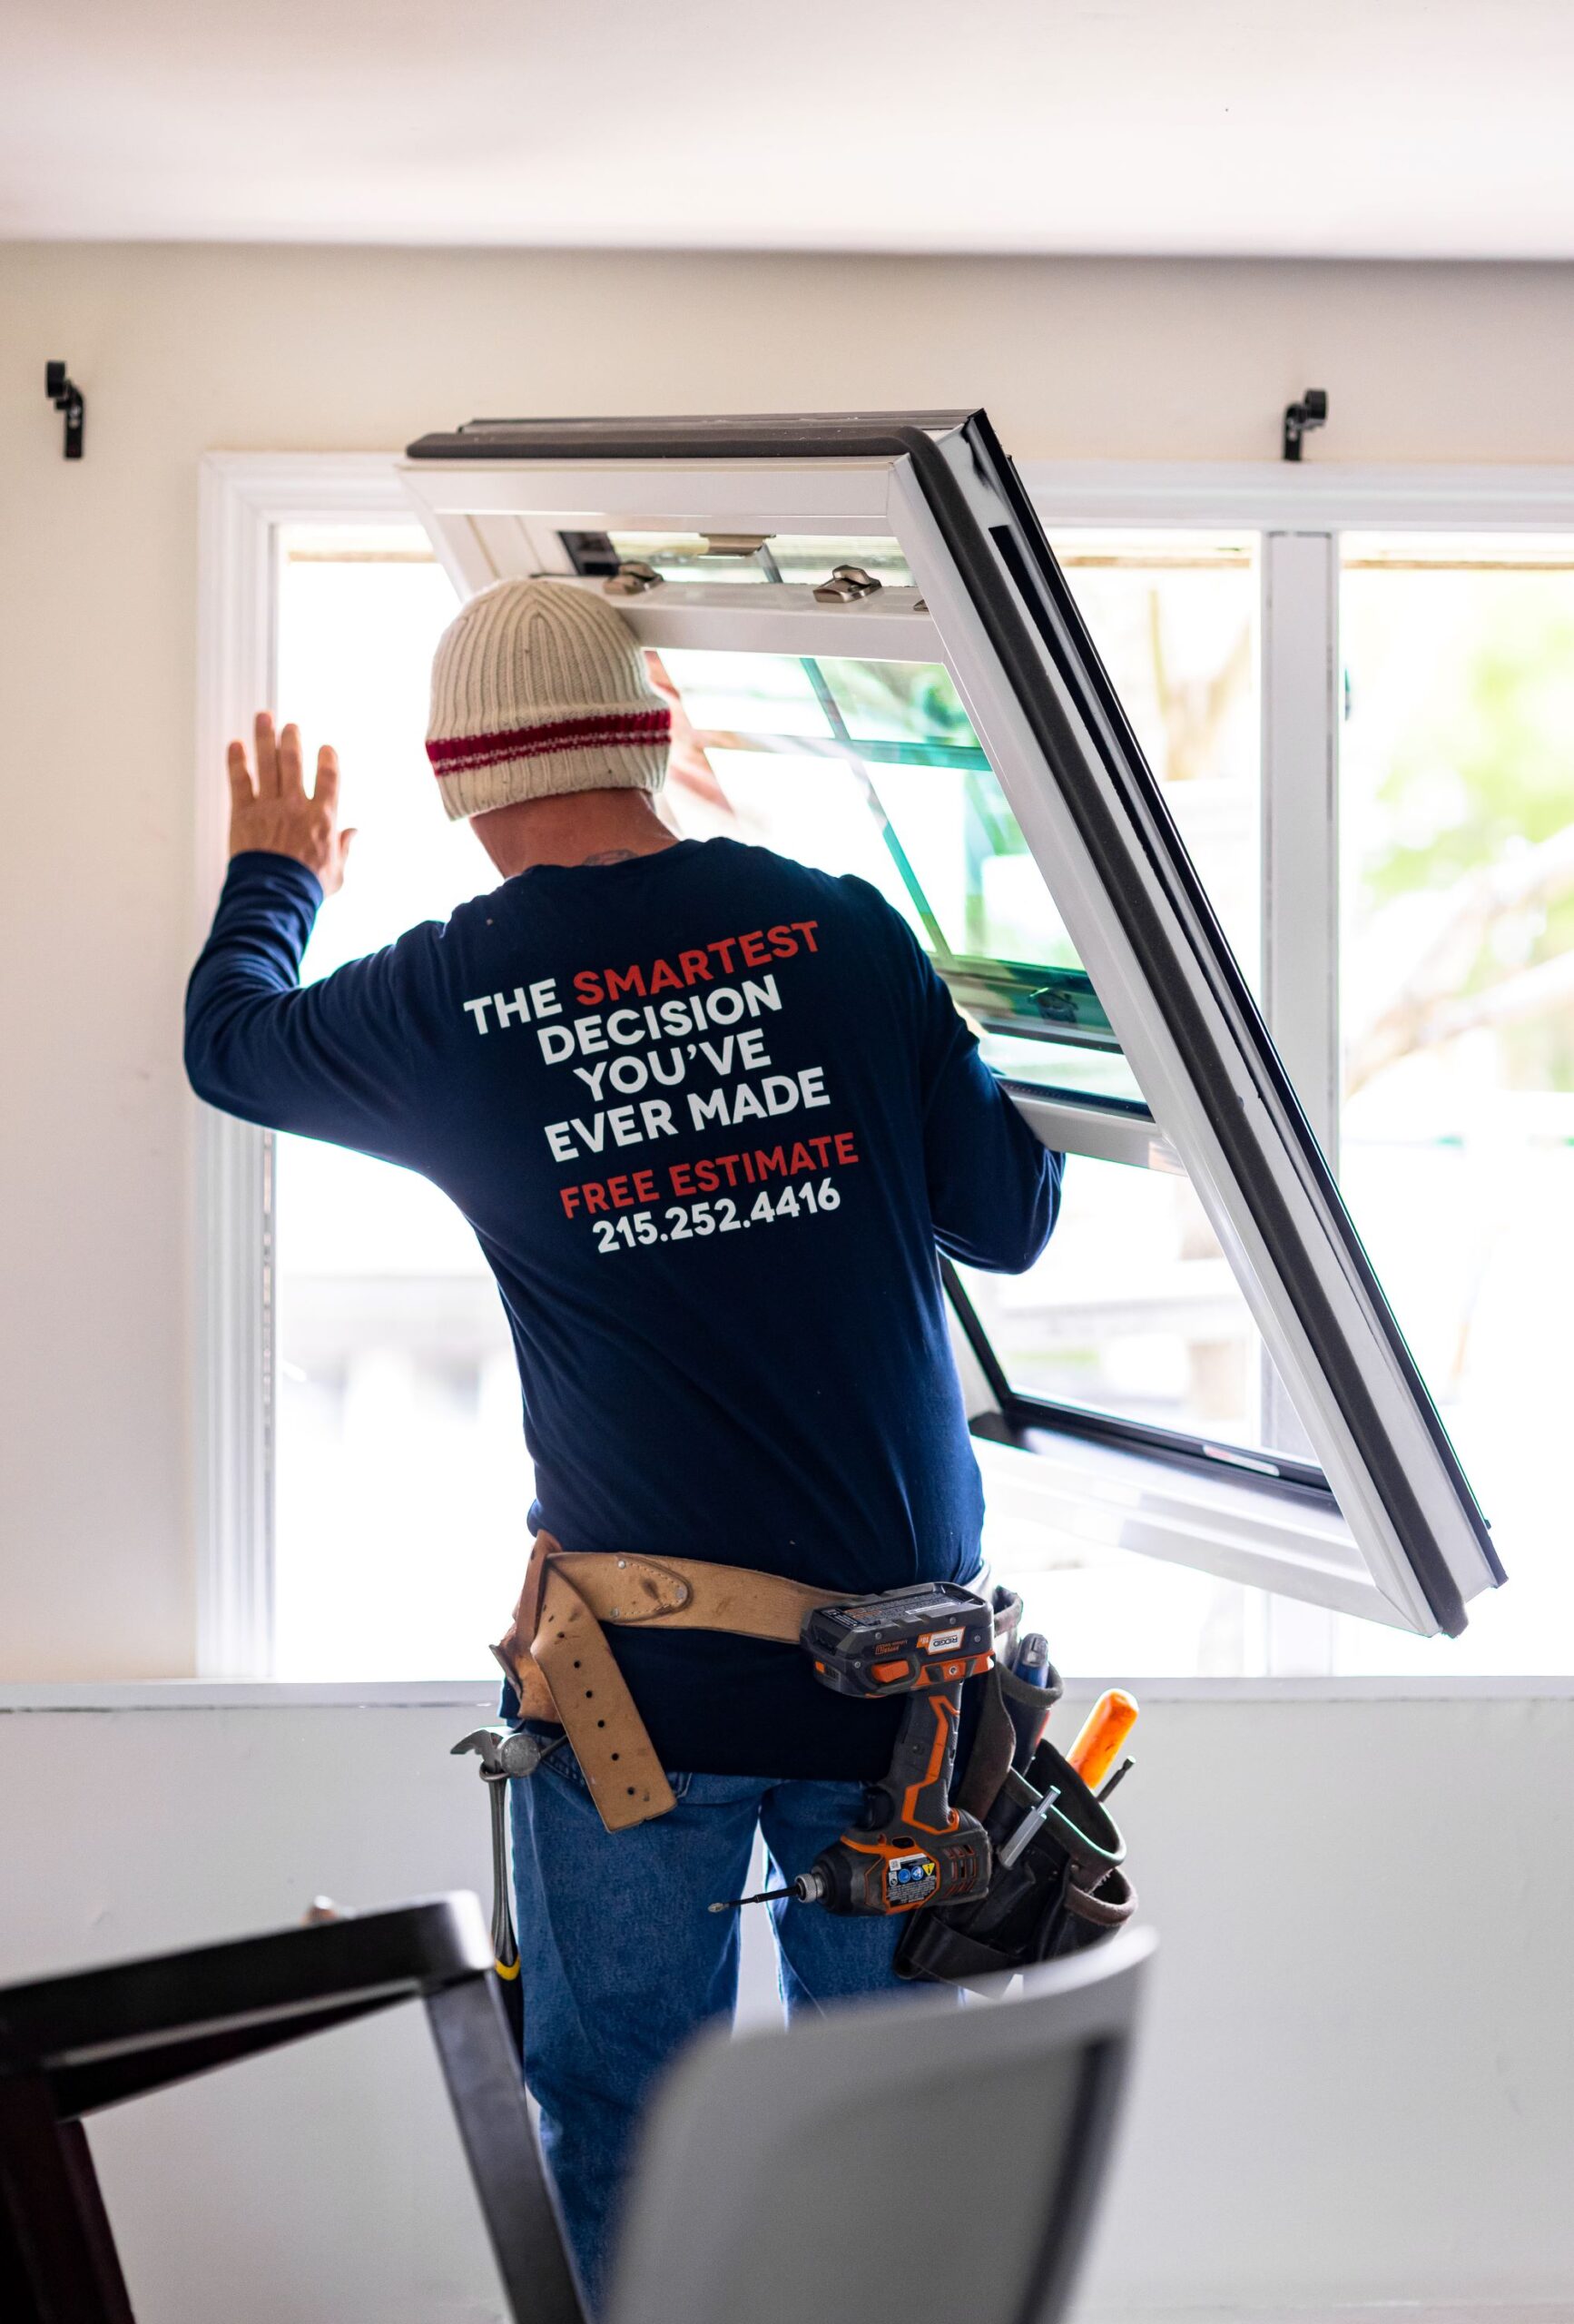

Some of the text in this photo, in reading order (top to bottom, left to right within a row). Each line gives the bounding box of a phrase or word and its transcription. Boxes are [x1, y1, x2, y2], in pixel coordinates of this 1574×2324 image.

[464, 921, 819, 1035] THE SMARTEST
[536, 974, 782, 1066] DECISION
[573, 1028, 772, 1102] YOU'VE
[544, 1066, 831, 1163] EVER MADE
[560, 1132, 859, 1219] FREE ESTIMATE
[592, 1177, 841, 1254] 215.252.4416
[932, 1635, 958, 1647] RIDGID
